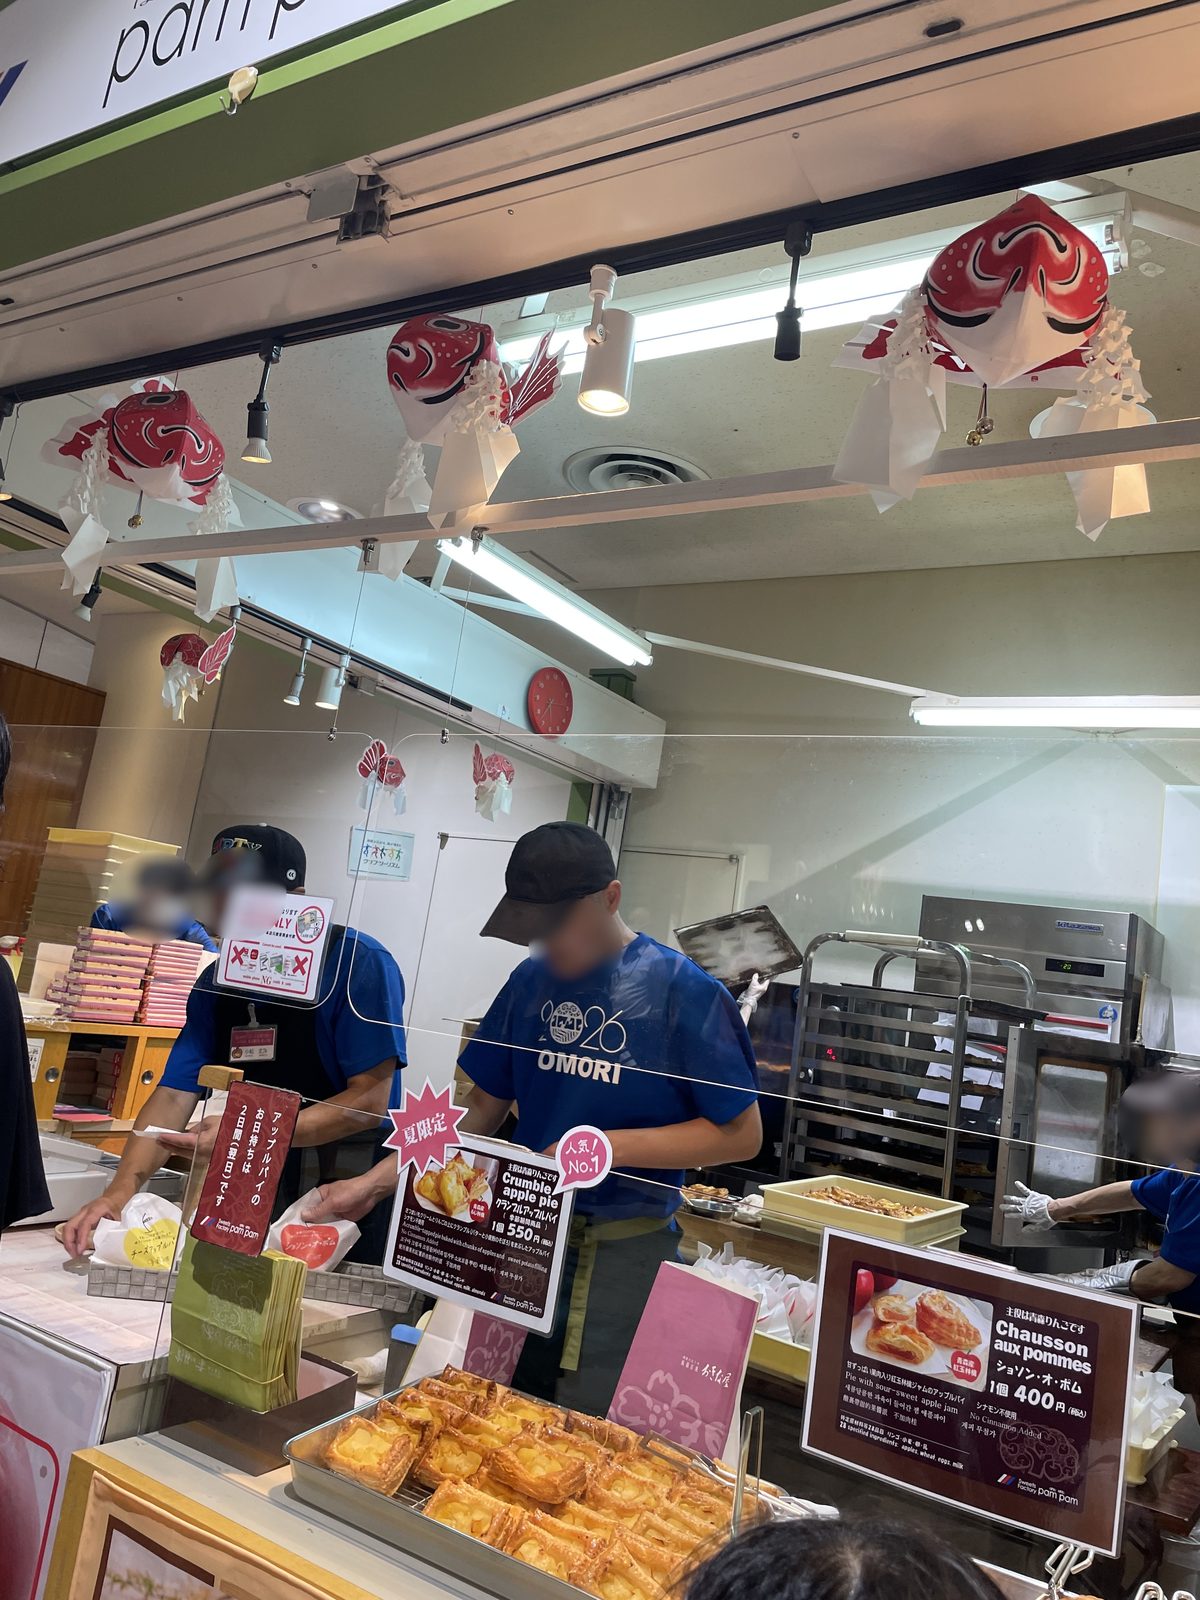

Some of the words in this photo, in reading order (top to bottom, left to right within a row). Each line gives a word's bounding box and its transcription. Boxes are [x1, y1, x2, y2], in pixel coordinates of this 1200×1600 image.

[242, 1107, 265, 1174] お日持ちは
[402, 1112, 448, 1148] 夏限定
[251, 1111, 282, 1206] アップルパイの
[568, 1155, 599, 1175] No.1
[501, 1170, 552, 1195] Crumble
[502, 1183, 537, 1206] apple
[538, 1193, 559, 1212] pie
[515, 1299, 529, 1311] pam
[528, 1304, 542, 1315] pam
[1005, 1305, 1085, 1335] 主役は青森りんごです
[995, 1319, 1088, 1358] Chausson
[993, 1337, 1021, 1356] aux
[1022, 1345, 1092, 1378] pommes
[989, 1379, 1008, 1397] 1個
[845, 1371, 856, 1381] Pie
[858, 1375, 873, 1387] with
[921, 1396, 942, 1410] apple
[943, 1403, 958, 1415] jam
[969, 1411, 980, 1421] No
[981, 1415, 1017, 1432] Cinnamon
[1017, 1426, 1042, 1440] Added
[976, 1400, 1017, 1421] シナモン不使用
[839, 1420, 846, 1429] 28
[1017, 1482, 1037, 1494] Factory
[1037, 1485, 1057, 1500] pam
[1058, 1492, 1078, 1508] pam
